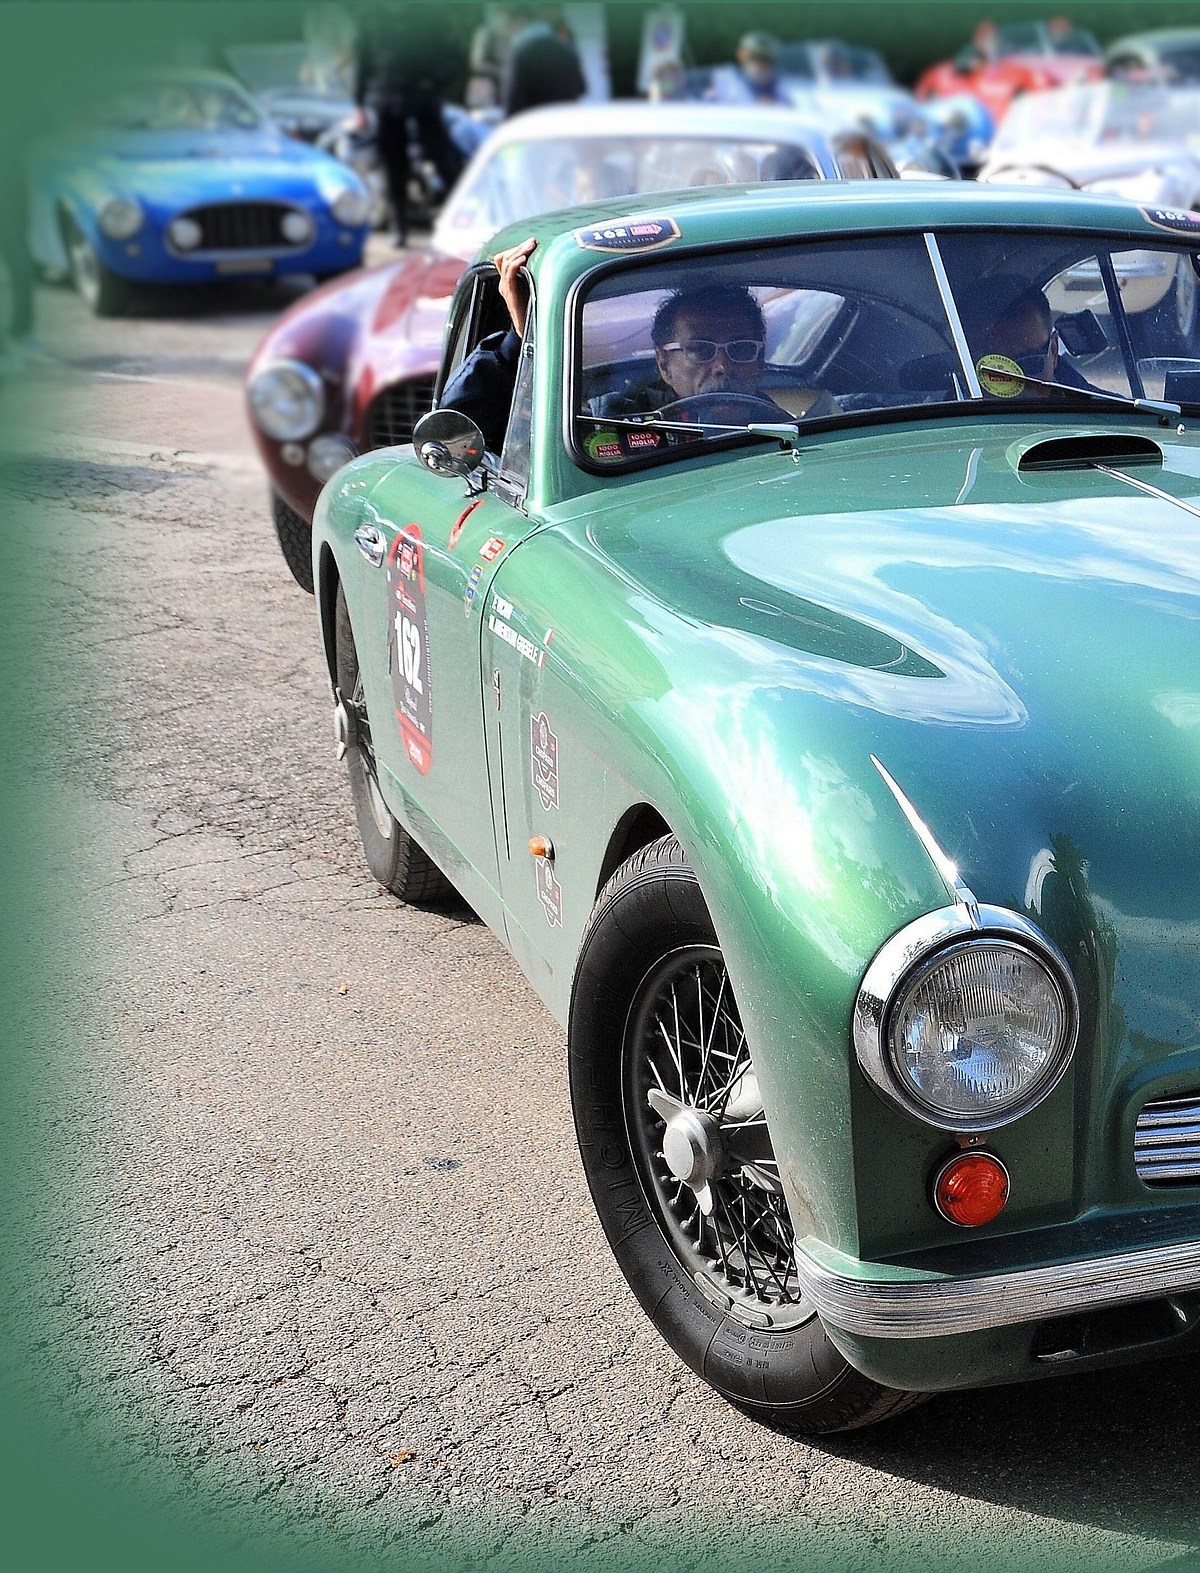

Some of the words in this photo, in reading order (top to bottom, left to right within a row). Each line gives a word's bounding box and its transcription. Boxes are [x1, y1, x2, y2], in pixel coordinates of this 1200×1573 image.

[1155, 210, 1186, 221] 162
[592, 227, 628, 241] 162
[631, 438, 655, 446] MIGLIA
[394, 610, 423, 695] 162
